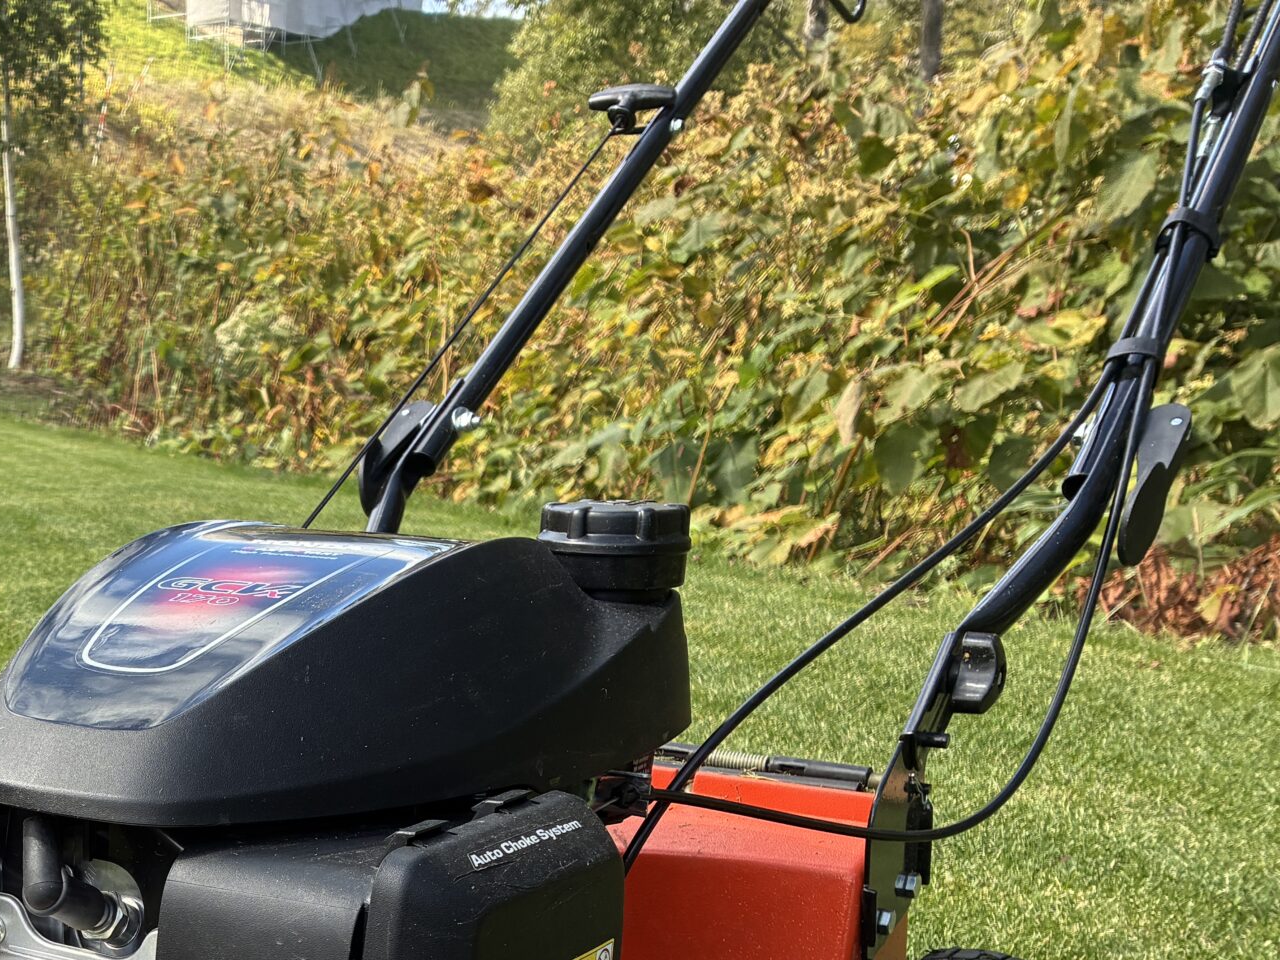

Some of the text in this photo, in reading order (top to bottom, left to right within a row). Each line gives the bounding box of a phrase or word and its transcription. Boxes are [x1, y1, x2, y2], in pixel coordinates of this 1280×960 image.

[169, 593, 240, 606] 170
[469, 819, 582, 867] Auto Choke System
